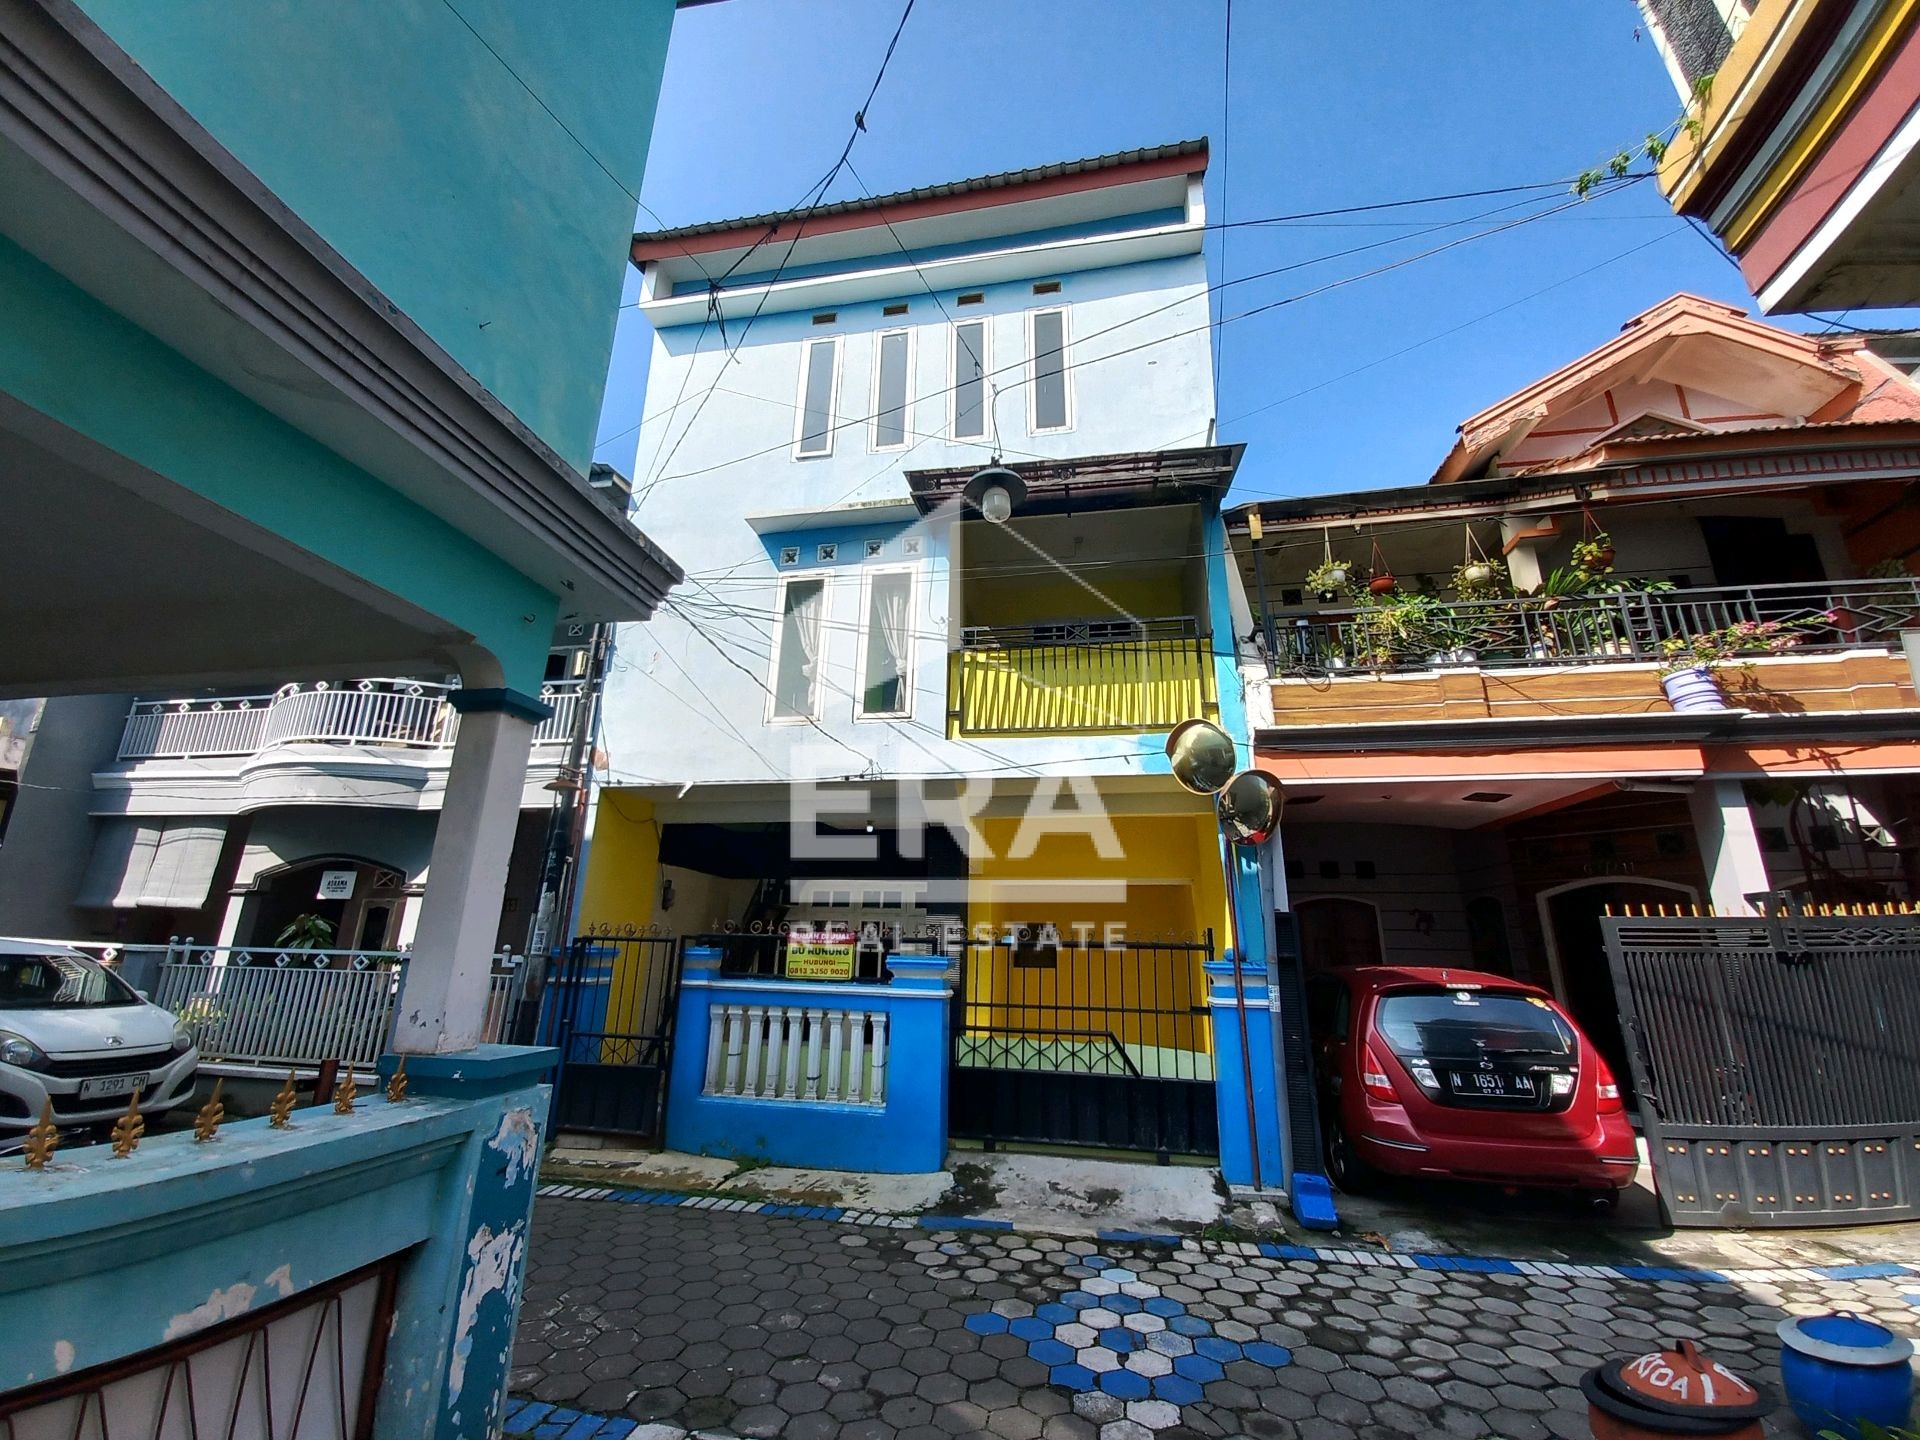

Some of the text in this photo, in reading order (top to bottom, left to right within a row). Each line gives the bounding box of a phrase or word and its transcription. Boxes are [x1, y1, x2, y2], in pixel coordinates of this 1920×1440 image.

[792, 947, 849, 956] BU NUNUNG
[100, 1079, 125, 1091] 1291
[132, 1075, 146, 1087] CH
[1452, 1073, 1531, 1089] N 1651 AA
